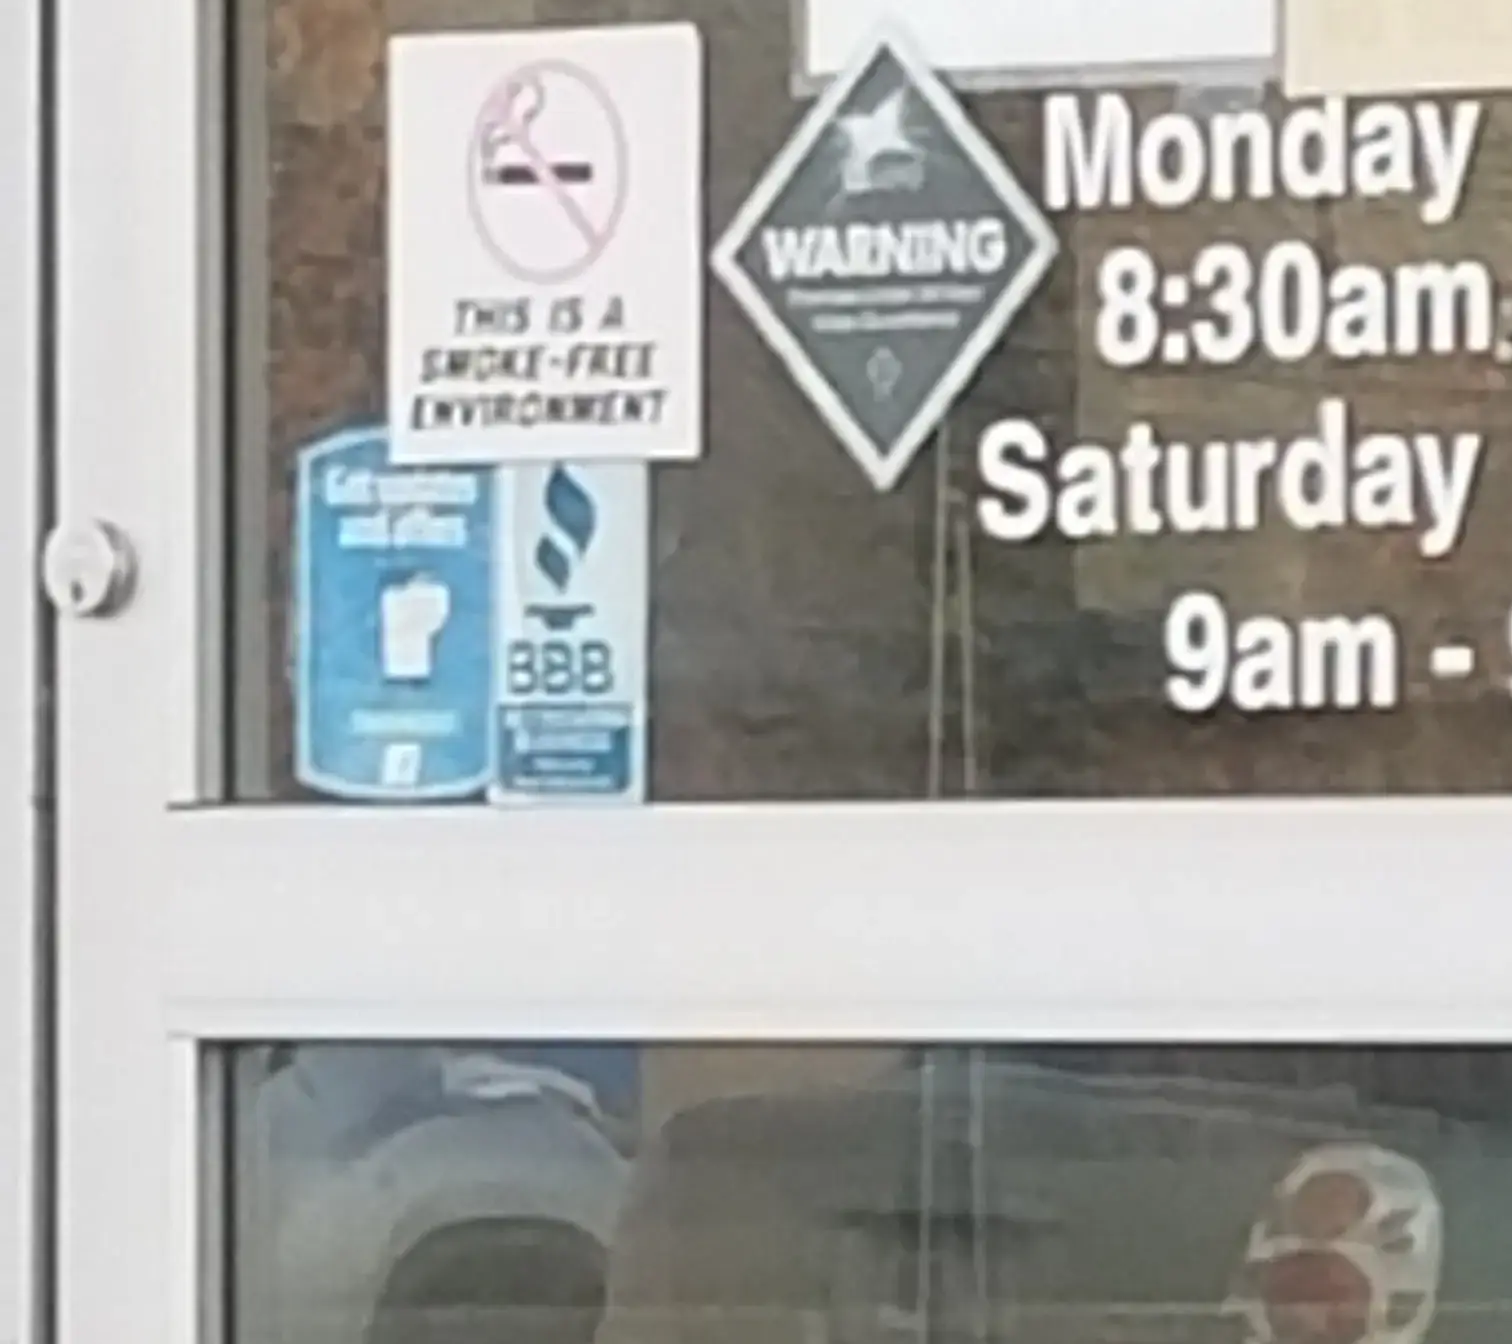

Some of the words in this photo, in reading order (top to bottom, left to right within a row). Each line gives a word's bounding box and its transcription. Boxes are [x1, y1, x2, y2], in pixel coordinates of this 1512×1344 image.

[1042, 90, 1482, 224] Monday
[762, 218, 1007, 280] WARNING
[453, 297, 532, 336] THIS
[548, 295, 582, 332] IS
[598, 295, 626, 329] A
[1096, 241, 1493, 366] 8:30am
[419, 341, 658, 384] SMOKE-FREE
[410, 388, 669, 431] ENVIRONMENT
[977, 395, 1482, 556] Saturday
[508, 640, 612, 695] BBB
[1163, 591, 1398, 710] 9am
